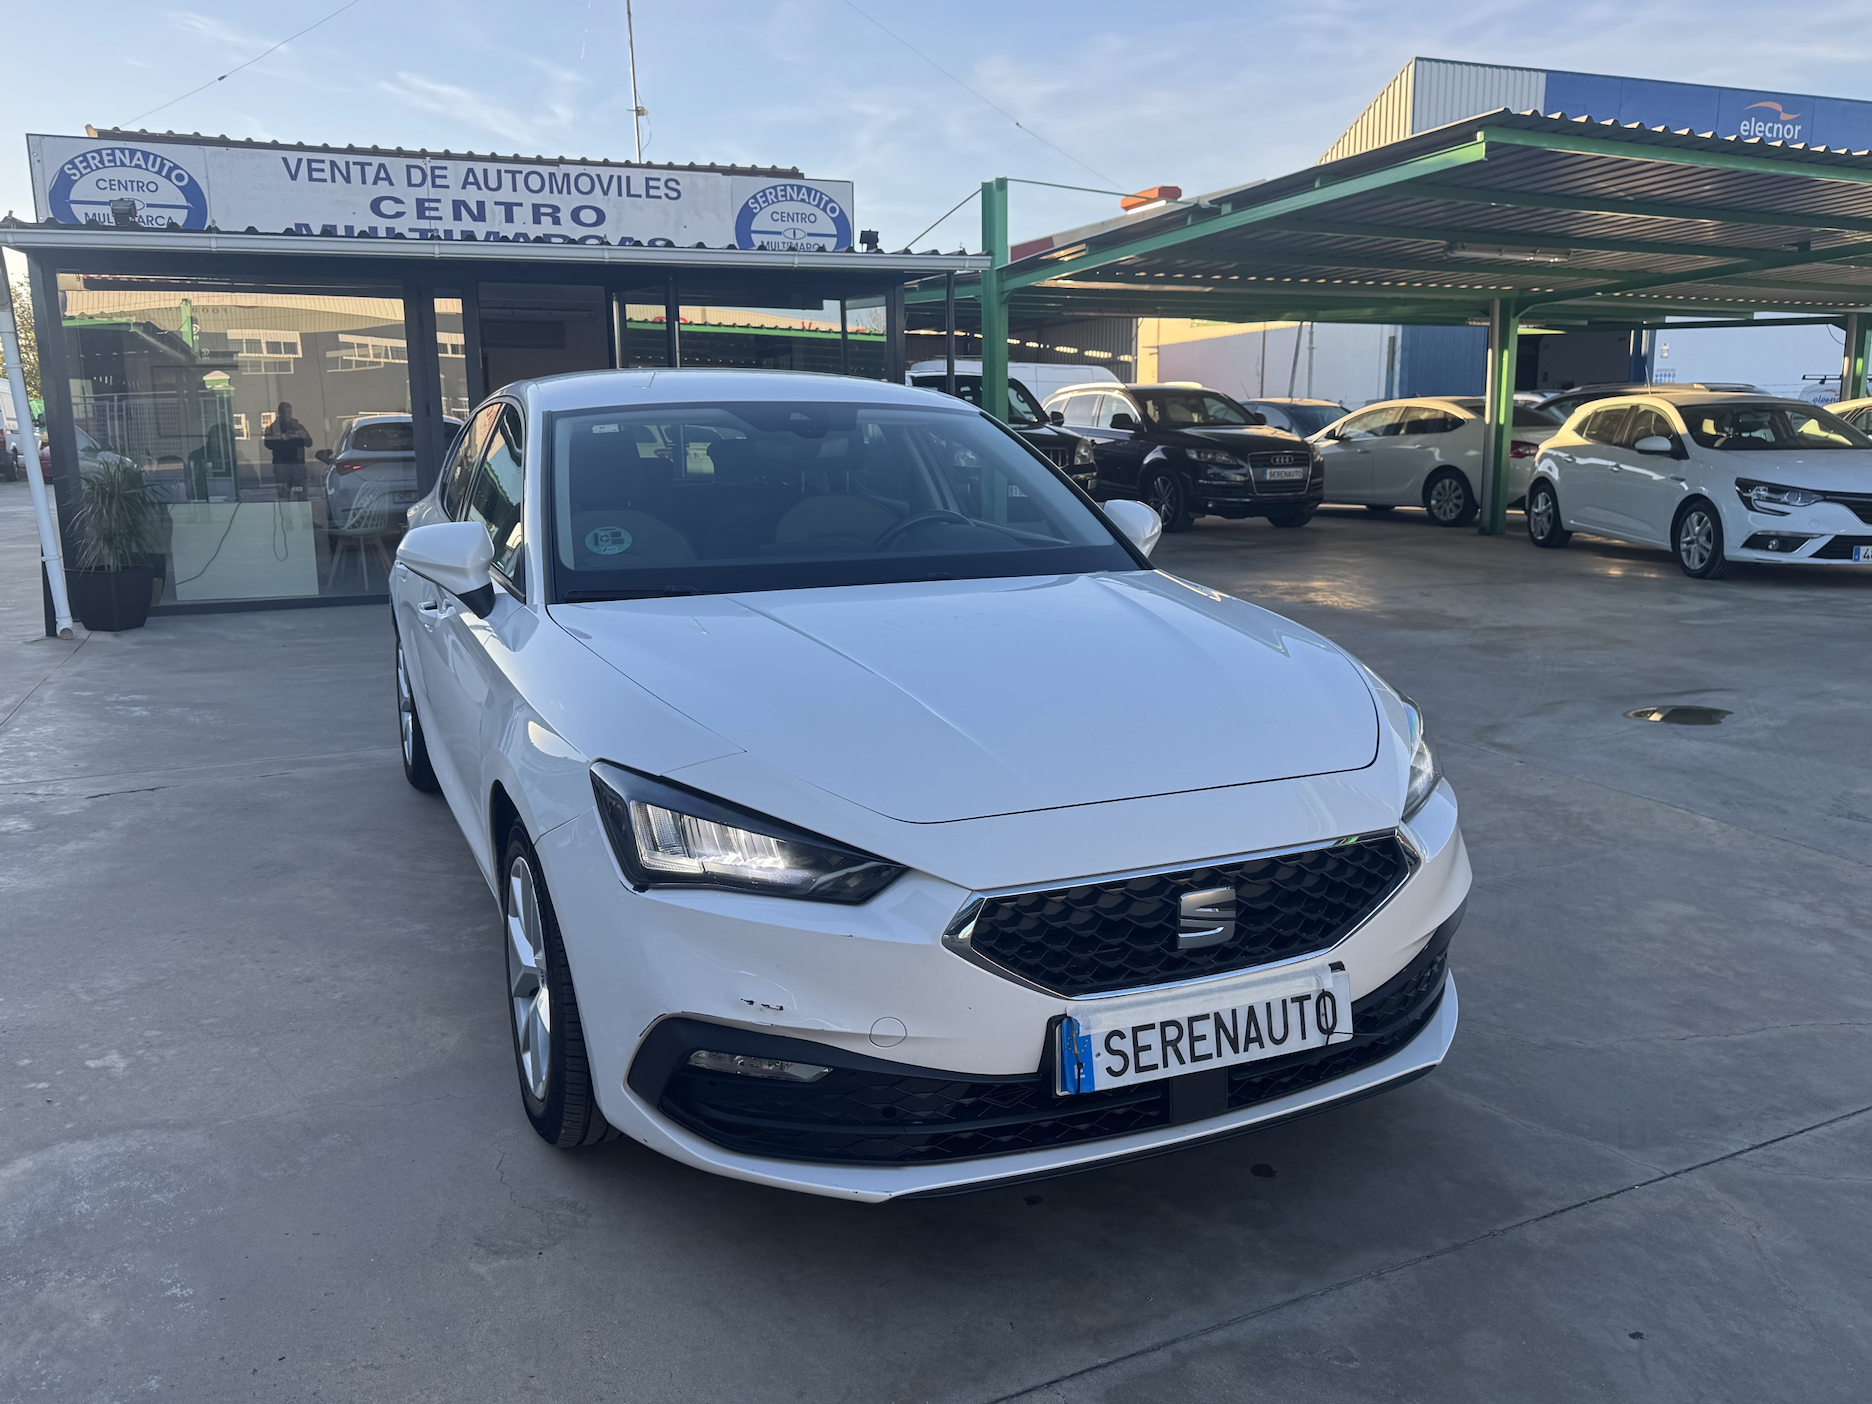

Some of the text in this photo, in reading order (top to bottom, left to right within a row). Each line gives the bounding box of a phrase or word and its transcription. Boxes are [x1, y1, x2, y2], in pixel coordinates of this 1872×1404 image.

[1740, 117, 1801, 139] elecnor
[64, 149, 189, 186] SERENAUTO
[281, 157, 682, 201] VENTA DE AUTOMOVILES
[95, 178, 159, 193] CENTRO
[748, 185, 840, 218] SERENAUTO
[370, 195, 607, 227] CENTRO
[770, 211, 818, 224] CENTRO
[1269, 470, 1302, 479] SERENAUTO
[1104, 990, 1337, 1077] SERENAUTO
